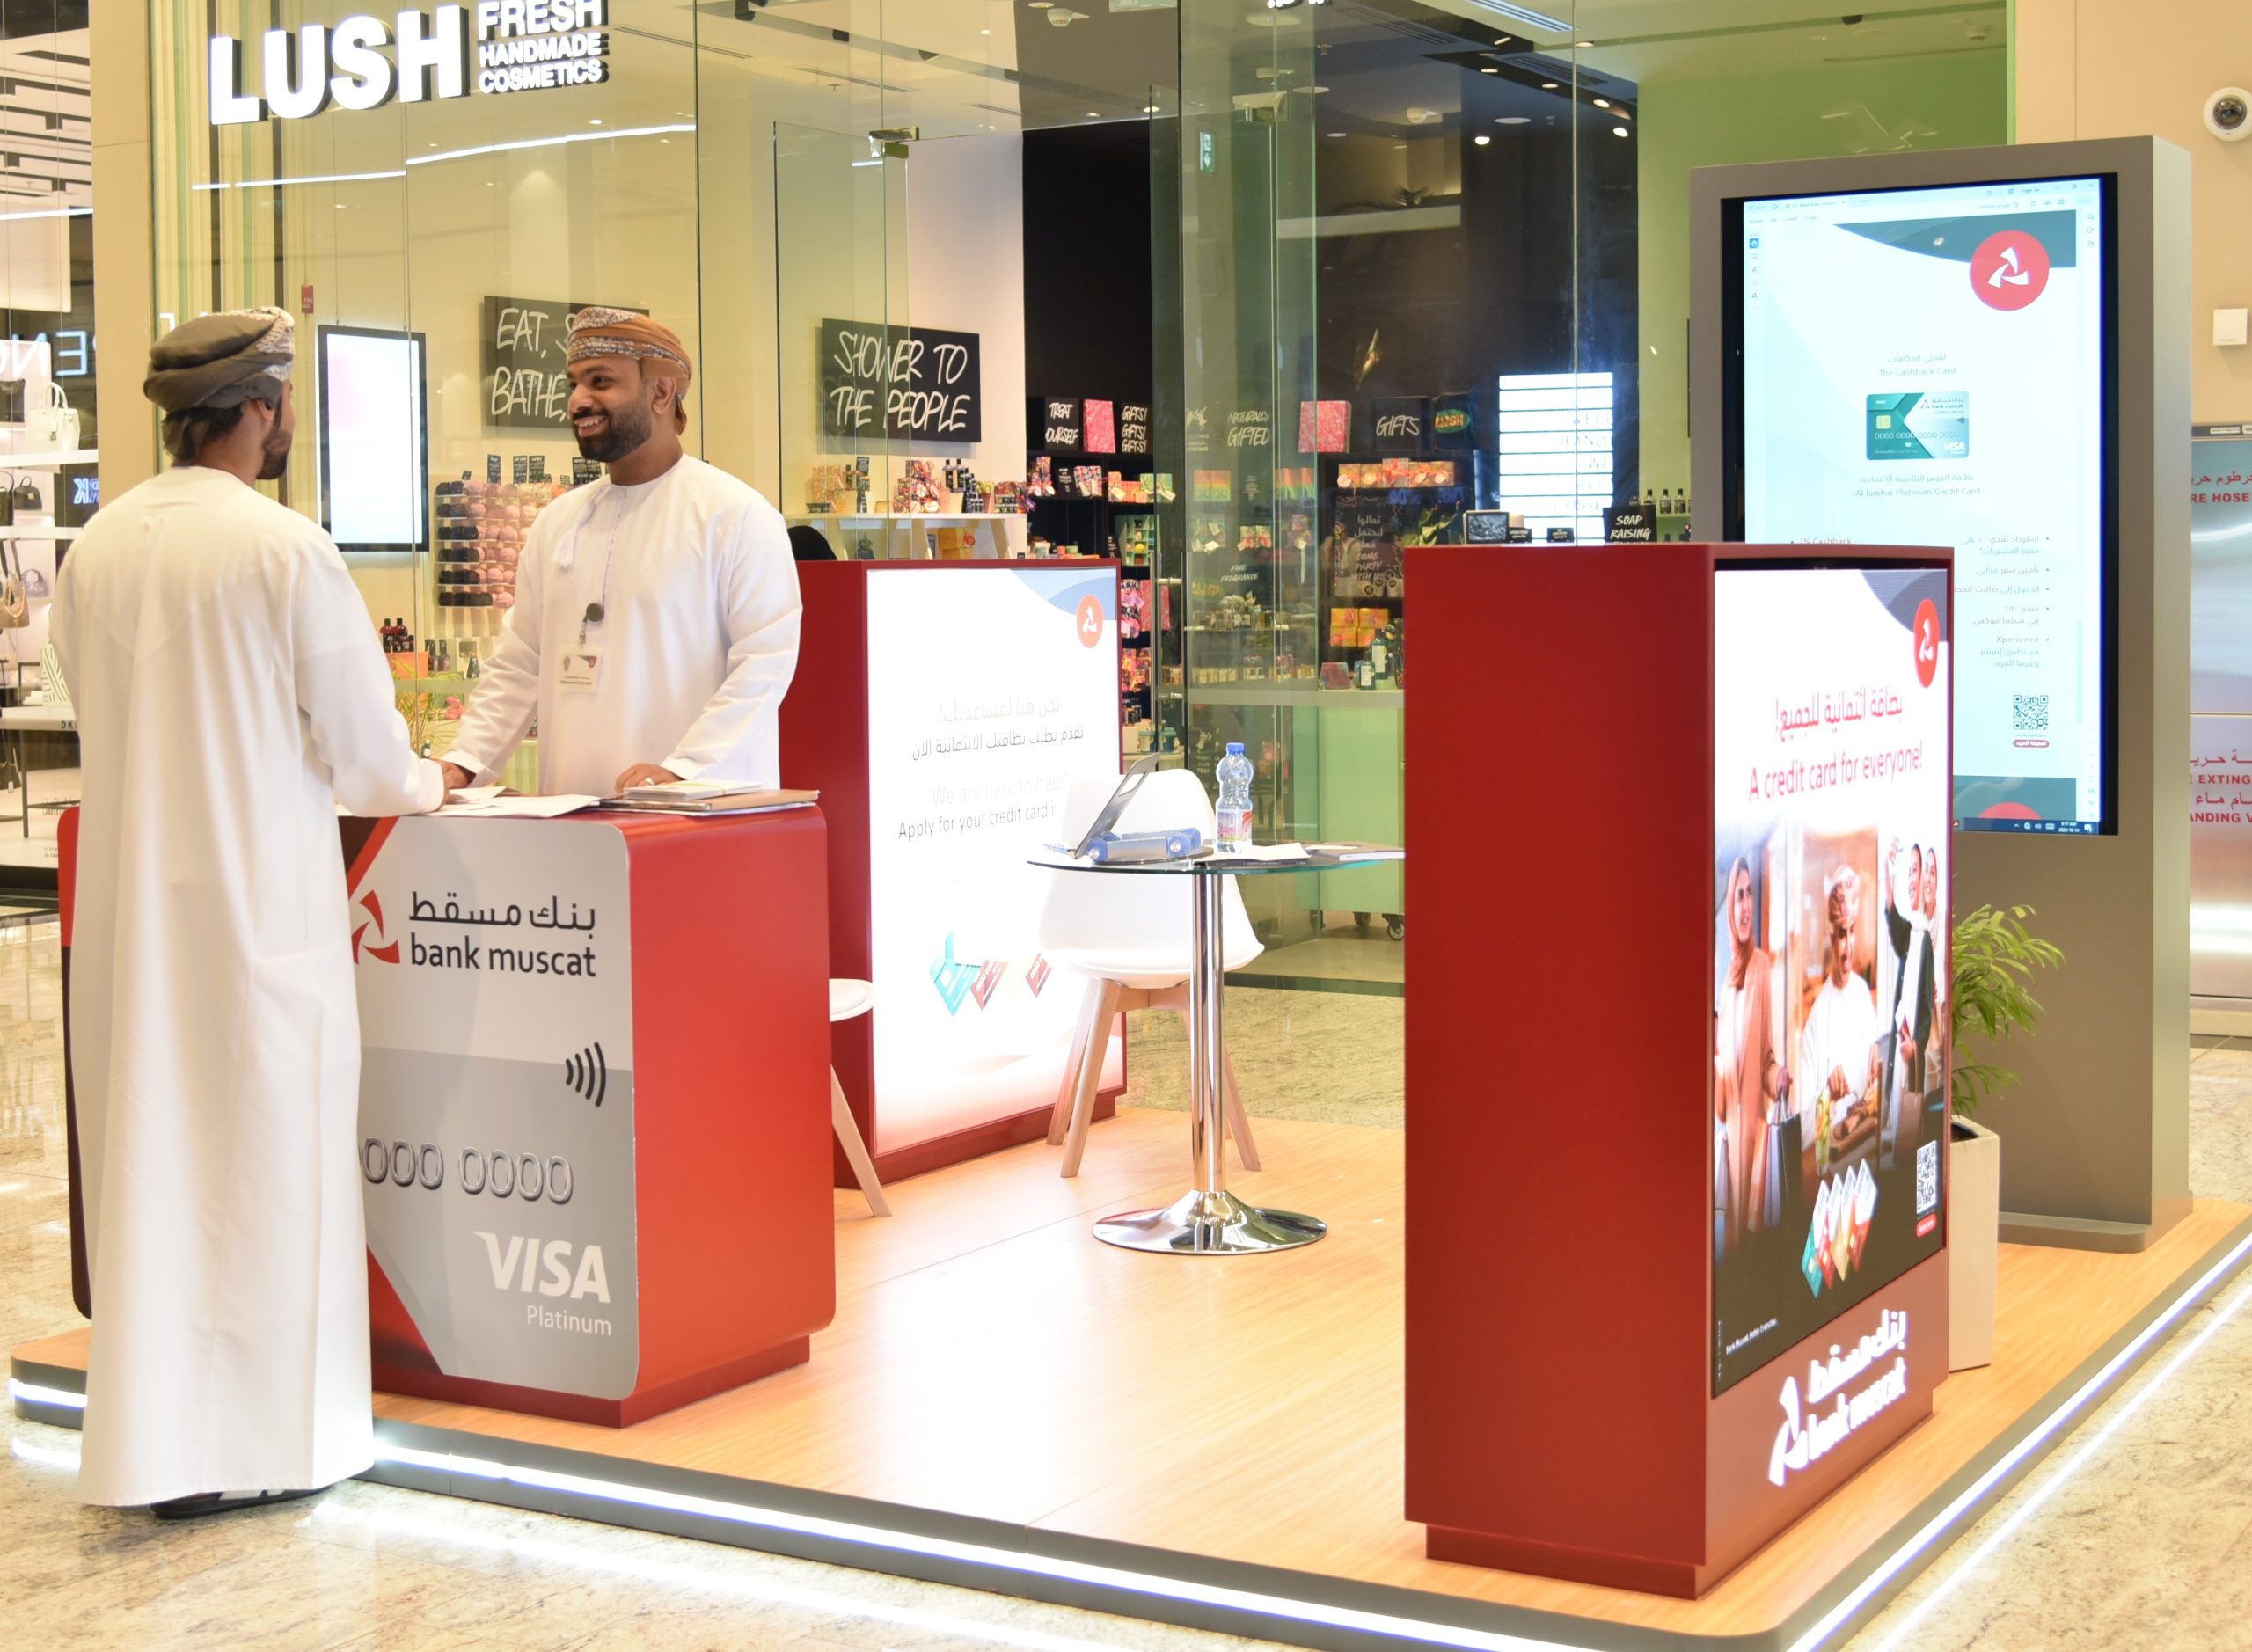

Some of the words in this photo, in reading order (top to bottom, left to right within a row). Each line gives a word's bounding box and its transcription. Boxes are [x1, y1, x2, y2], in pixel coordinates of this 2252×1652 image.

[478, 0, 603, 40] FRESH
[211, 5, 463, 125] LUSH
[479, 32, 603, 68] HANDMADE
[478, 58, 603, 94] COSMETICS
[496, 308, 549, 359] EAT,
[833, 331, 924, 383] SHOWER
[933, 344, 968, 384] TO
[1879, 368, 1893, 376] The
[1895, 368, 1934, 376] Cashback
[830, 386, 874, 428] THE
[883, 389, 971, 433] PEOPLE
[1122, 406, 1148, 422] GIFTS!
[1376, 414, 1421, 436] GIFTS
[1121, 423, 1147, 439] GIFTS!
[1121, 438, 1147, 453] GIFTS!
[1227, 426, 1270, 447] GIFTED
[1942, 442, 1965, 450] VISA
[1896, 487, 1933, 496] Platinum
[2191, 493, 2206, 503] RE
[2212, 493, 2250, 503] HOSE
[1609, 528, 1652, 540] RAISING
[1615, 515, 1643, 527] SOAP
[1995, 635, 2040, 645] Xperience
[1870, 684, 1902, 724] بطاقة
[61, 720, 77, 729] DK
[1060, 723, 1085, 747] تقدم
[1749, 767, 1760, 802] A
[1764, 759, 1805, 800] credit
[1809, 752, 1837, 791] card
[1840, 750, 1860, 783] for
[1862, 738, 1923, 782] everyone!
[932, 786, 954, 807] We
[897, 817, 935, 842] Apply
[938, 816, 955, 833] for
[958, 815, 986, 835] your
[989, 805, 1021, 825] credit
[1025, 801, 1049, 822] card
[409, 890, 523, 927] مسقط
[528, 895, 596, 940] بنك
[410, 932, 482, 970] bank
[489, 946, 597, 978] muscat
[360, 1136, 444, 1190] 000
[457, 1145, 574, 1205] 0000
[472, 1231, 611, 1304] VISA
[527, 1304, 612, 1337] Platinum
